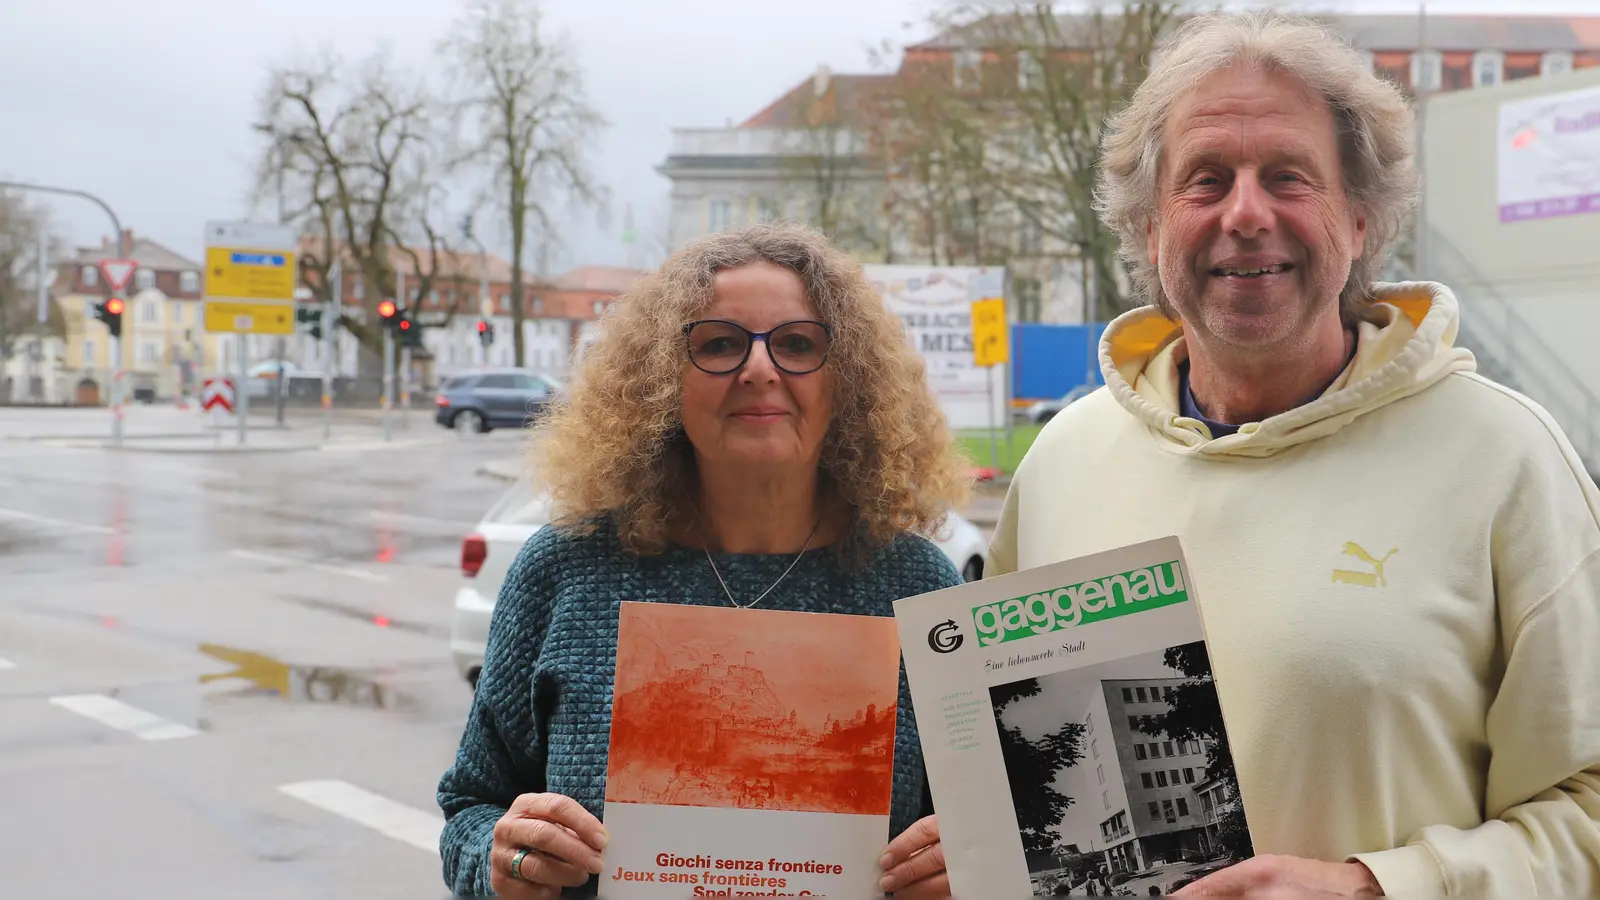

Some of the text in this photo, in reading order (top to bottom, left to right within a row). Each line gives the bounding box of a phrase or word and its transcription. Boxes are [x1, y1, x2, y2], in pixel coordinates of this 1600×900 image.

[974, 560, 1186, 646] gaggenau
[984, 640, 1086, 673] Eine liebenswerte Stadt
[655, 852, 843, 874] Giochi senza frontiere
[612, 866, 787, 888] Jeux sans frontières
